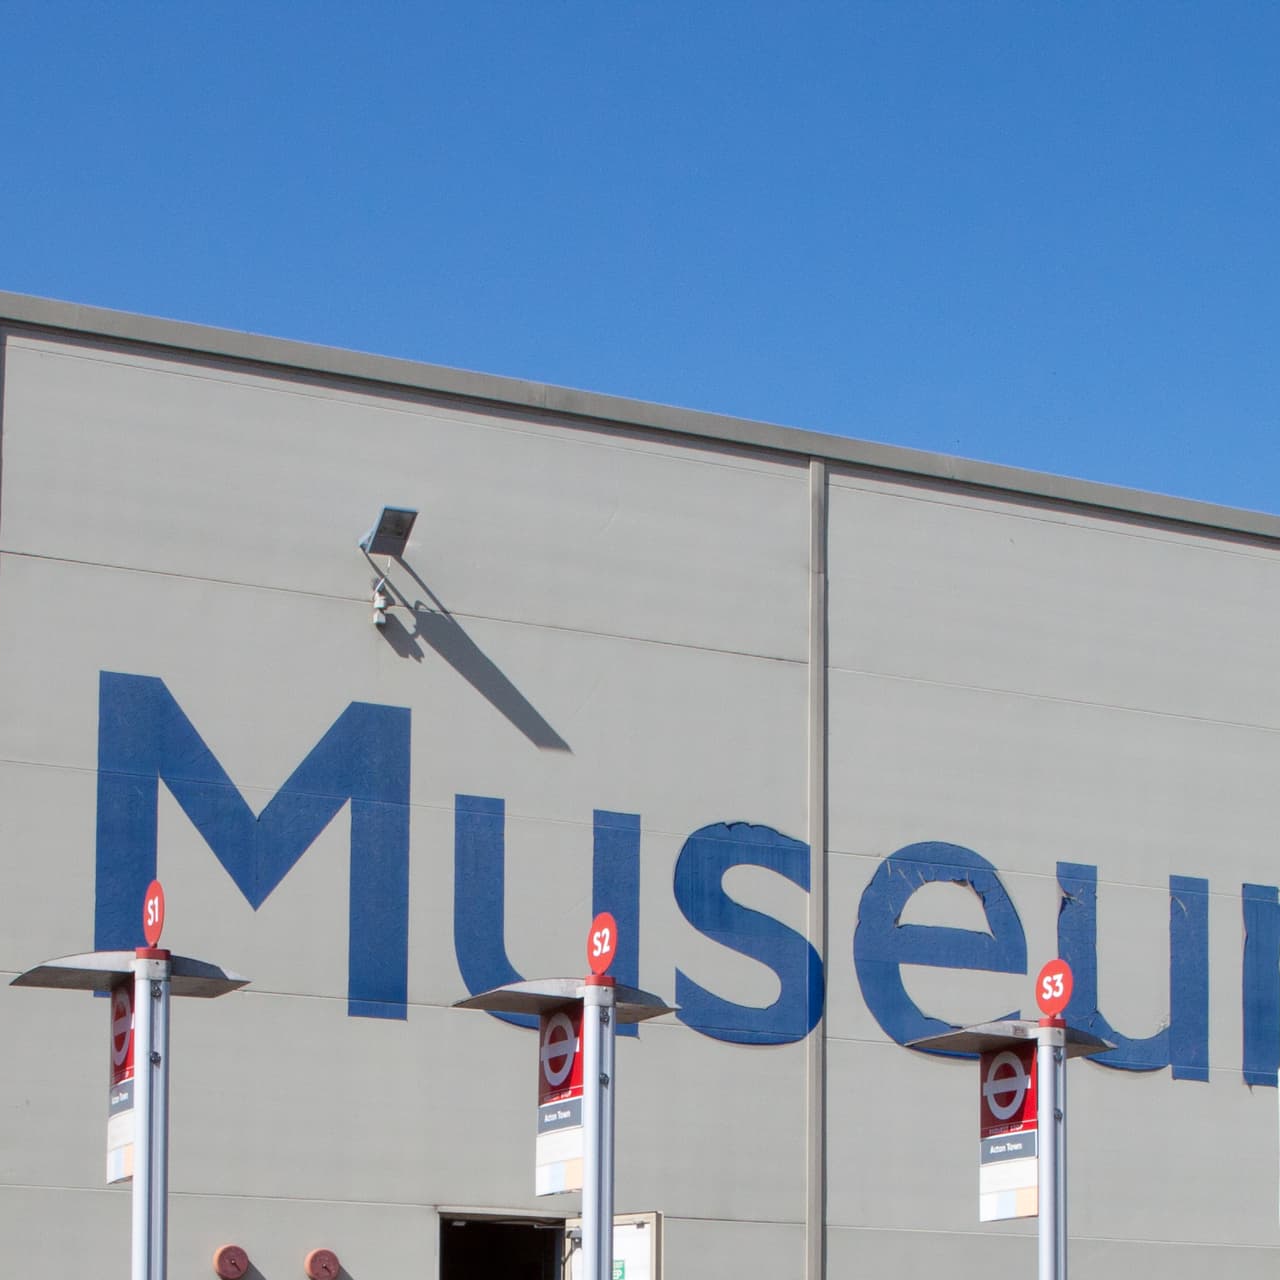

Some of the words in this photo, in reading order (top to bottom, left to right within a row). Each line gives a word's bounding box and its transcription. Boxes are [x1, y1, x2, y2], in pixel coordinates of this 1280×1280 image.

[147, 896, 159, 926] S1
[593, 928, 610, 957] S2
[1042, 973, 1064, 1000] S3
